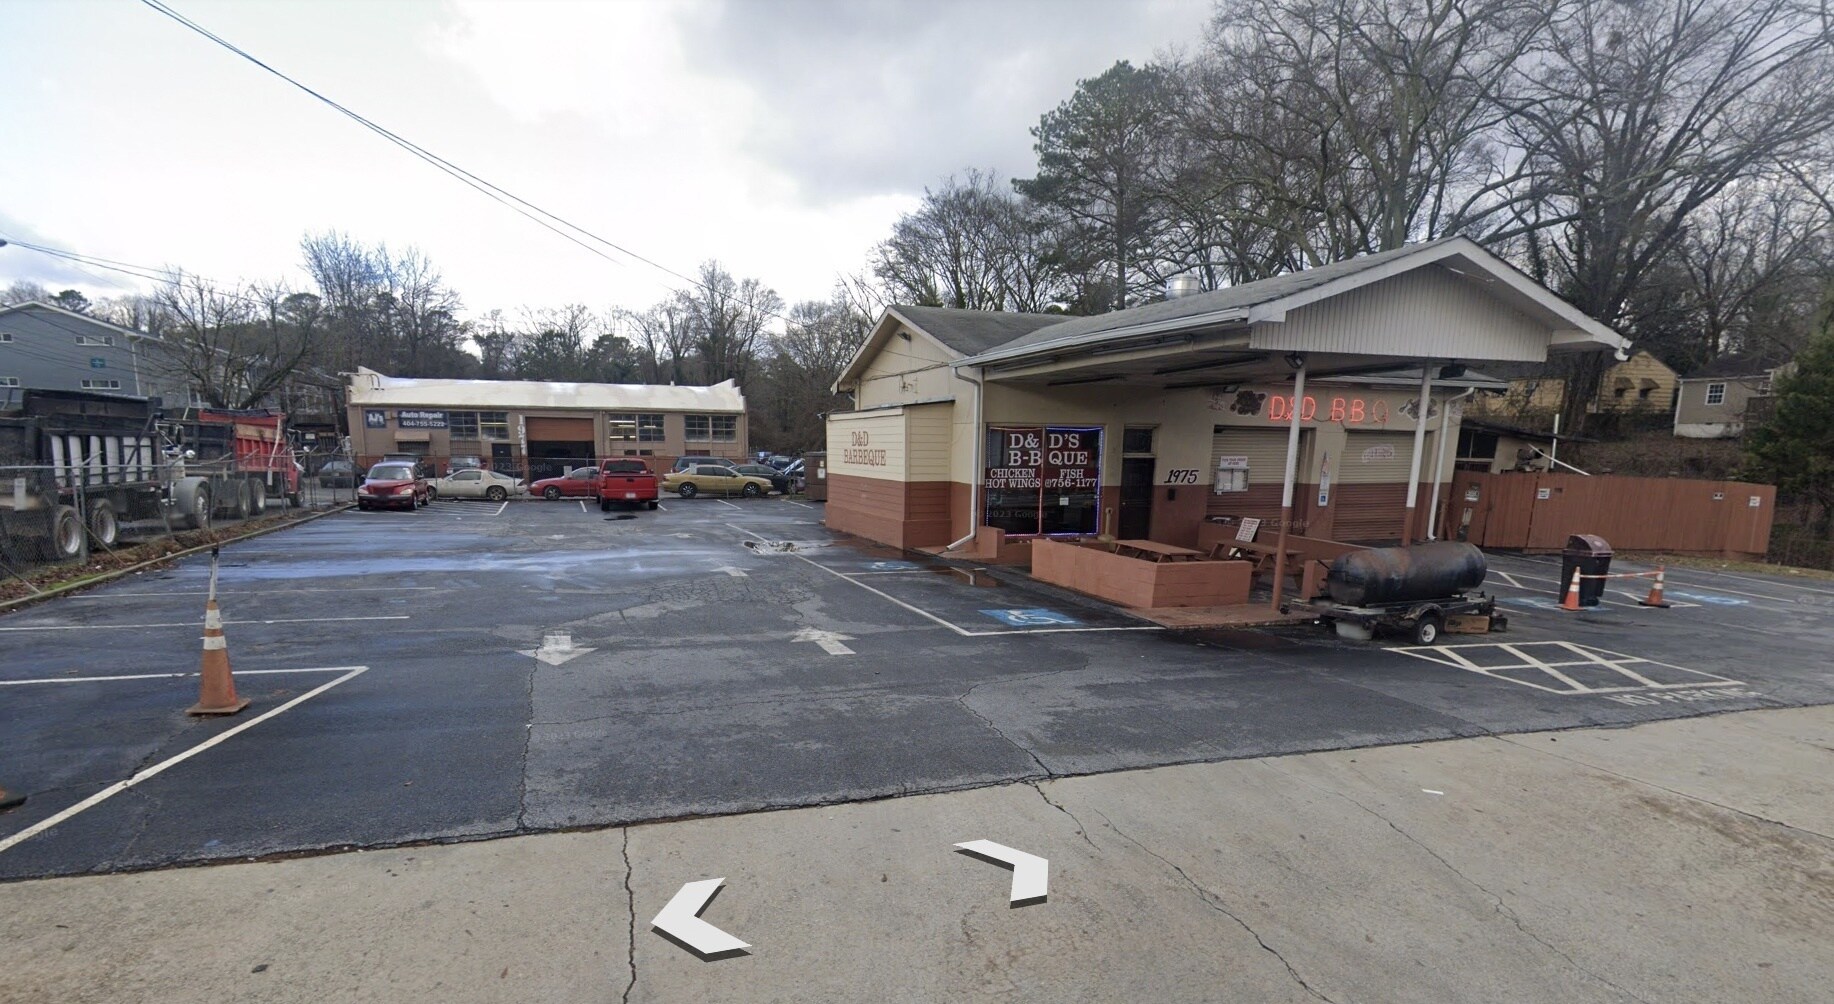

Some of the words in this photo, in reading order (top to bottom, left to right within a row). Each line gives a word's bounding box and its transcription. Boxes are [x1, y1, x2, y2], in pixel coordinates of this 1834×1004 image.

[401, 411, 418, 419] Auto
[419, 411, 444, 420] Repair
[1331, 398, 1389, 423] BBQ
[851, 431, 869, 447] D&D
[1009, 433, 1039, 448] D&
[1048, 433, 1080, 448] D'S
[843, 449, 886, 467] BARBEQUE
[1008, 450, 1042, 466] B-B
[1048, 450, 1088, 466] QUE
[990, 468, 1036, 478] CHICKEN
[1060, 468, 1084, 479] FISH
[1163, 469, 1200, 483] 1975
[985, 478, 1007, 488] HOT
[1009, 478, 1041, 488] WINGS
